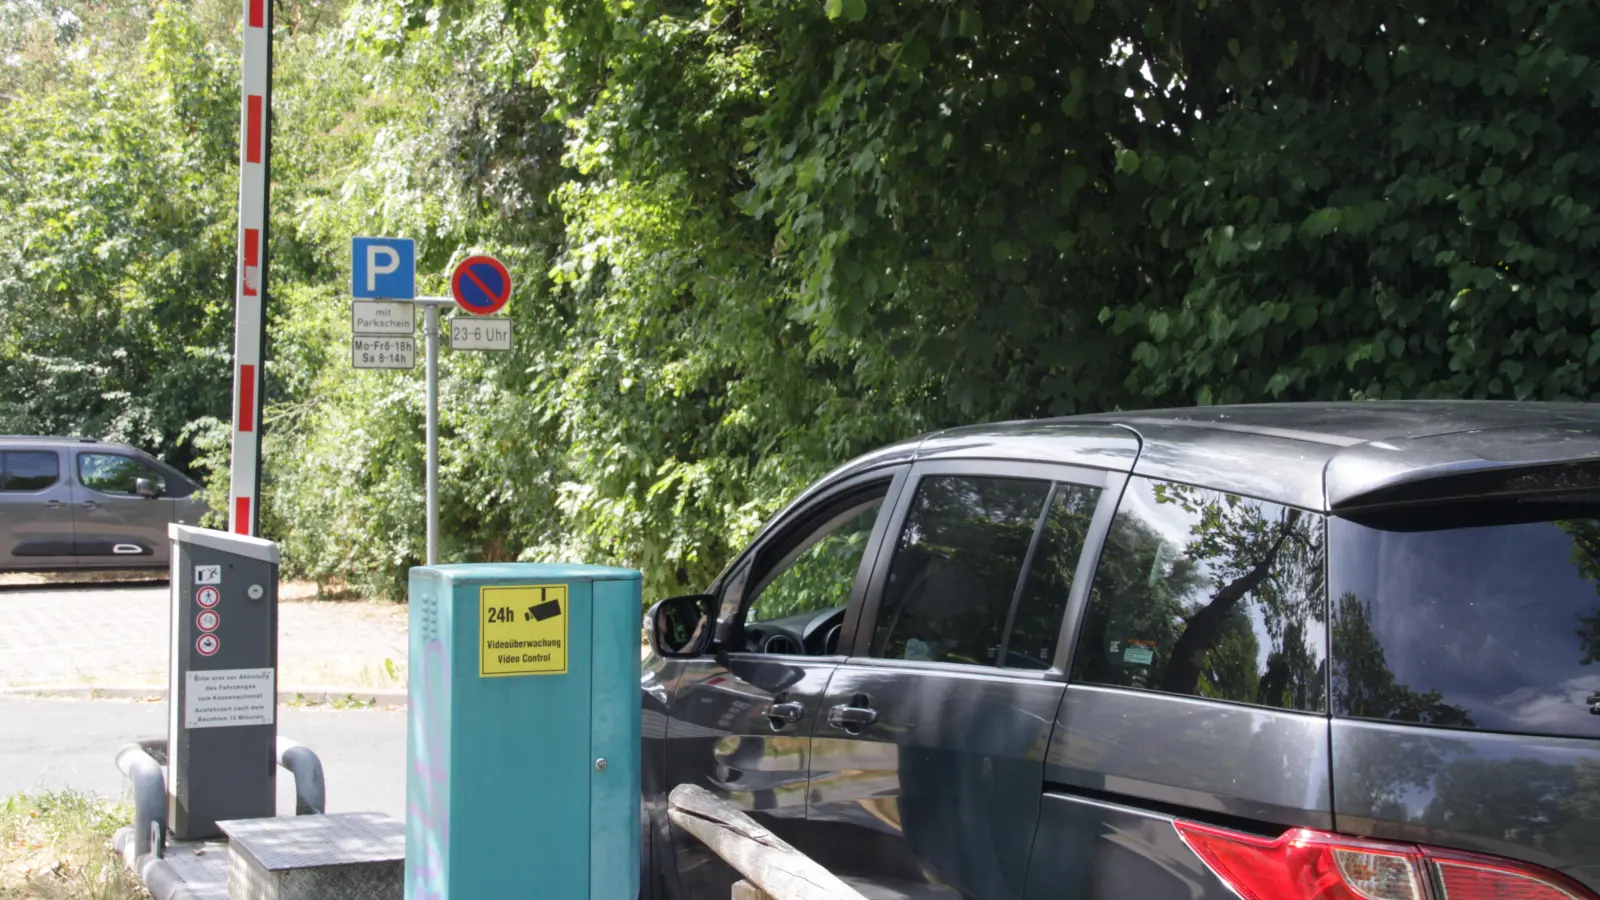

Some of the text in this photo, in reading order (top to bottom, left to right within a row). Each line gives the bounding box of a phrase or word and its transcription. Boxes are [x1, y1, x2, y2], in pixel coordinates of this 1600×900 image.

[367, 245, 400, 291] P
[375, 309, 391, 317] mit
[357, 318, 410, 328] Parkschein
[486, 328, 507, 342] Uhr
[362, 352, 375, 363] Sa
[488, 606, 514, 623] 24h
[487, 639, 561, 649] Videoüberwachung
[498, 653, 551, 664] Video Control
